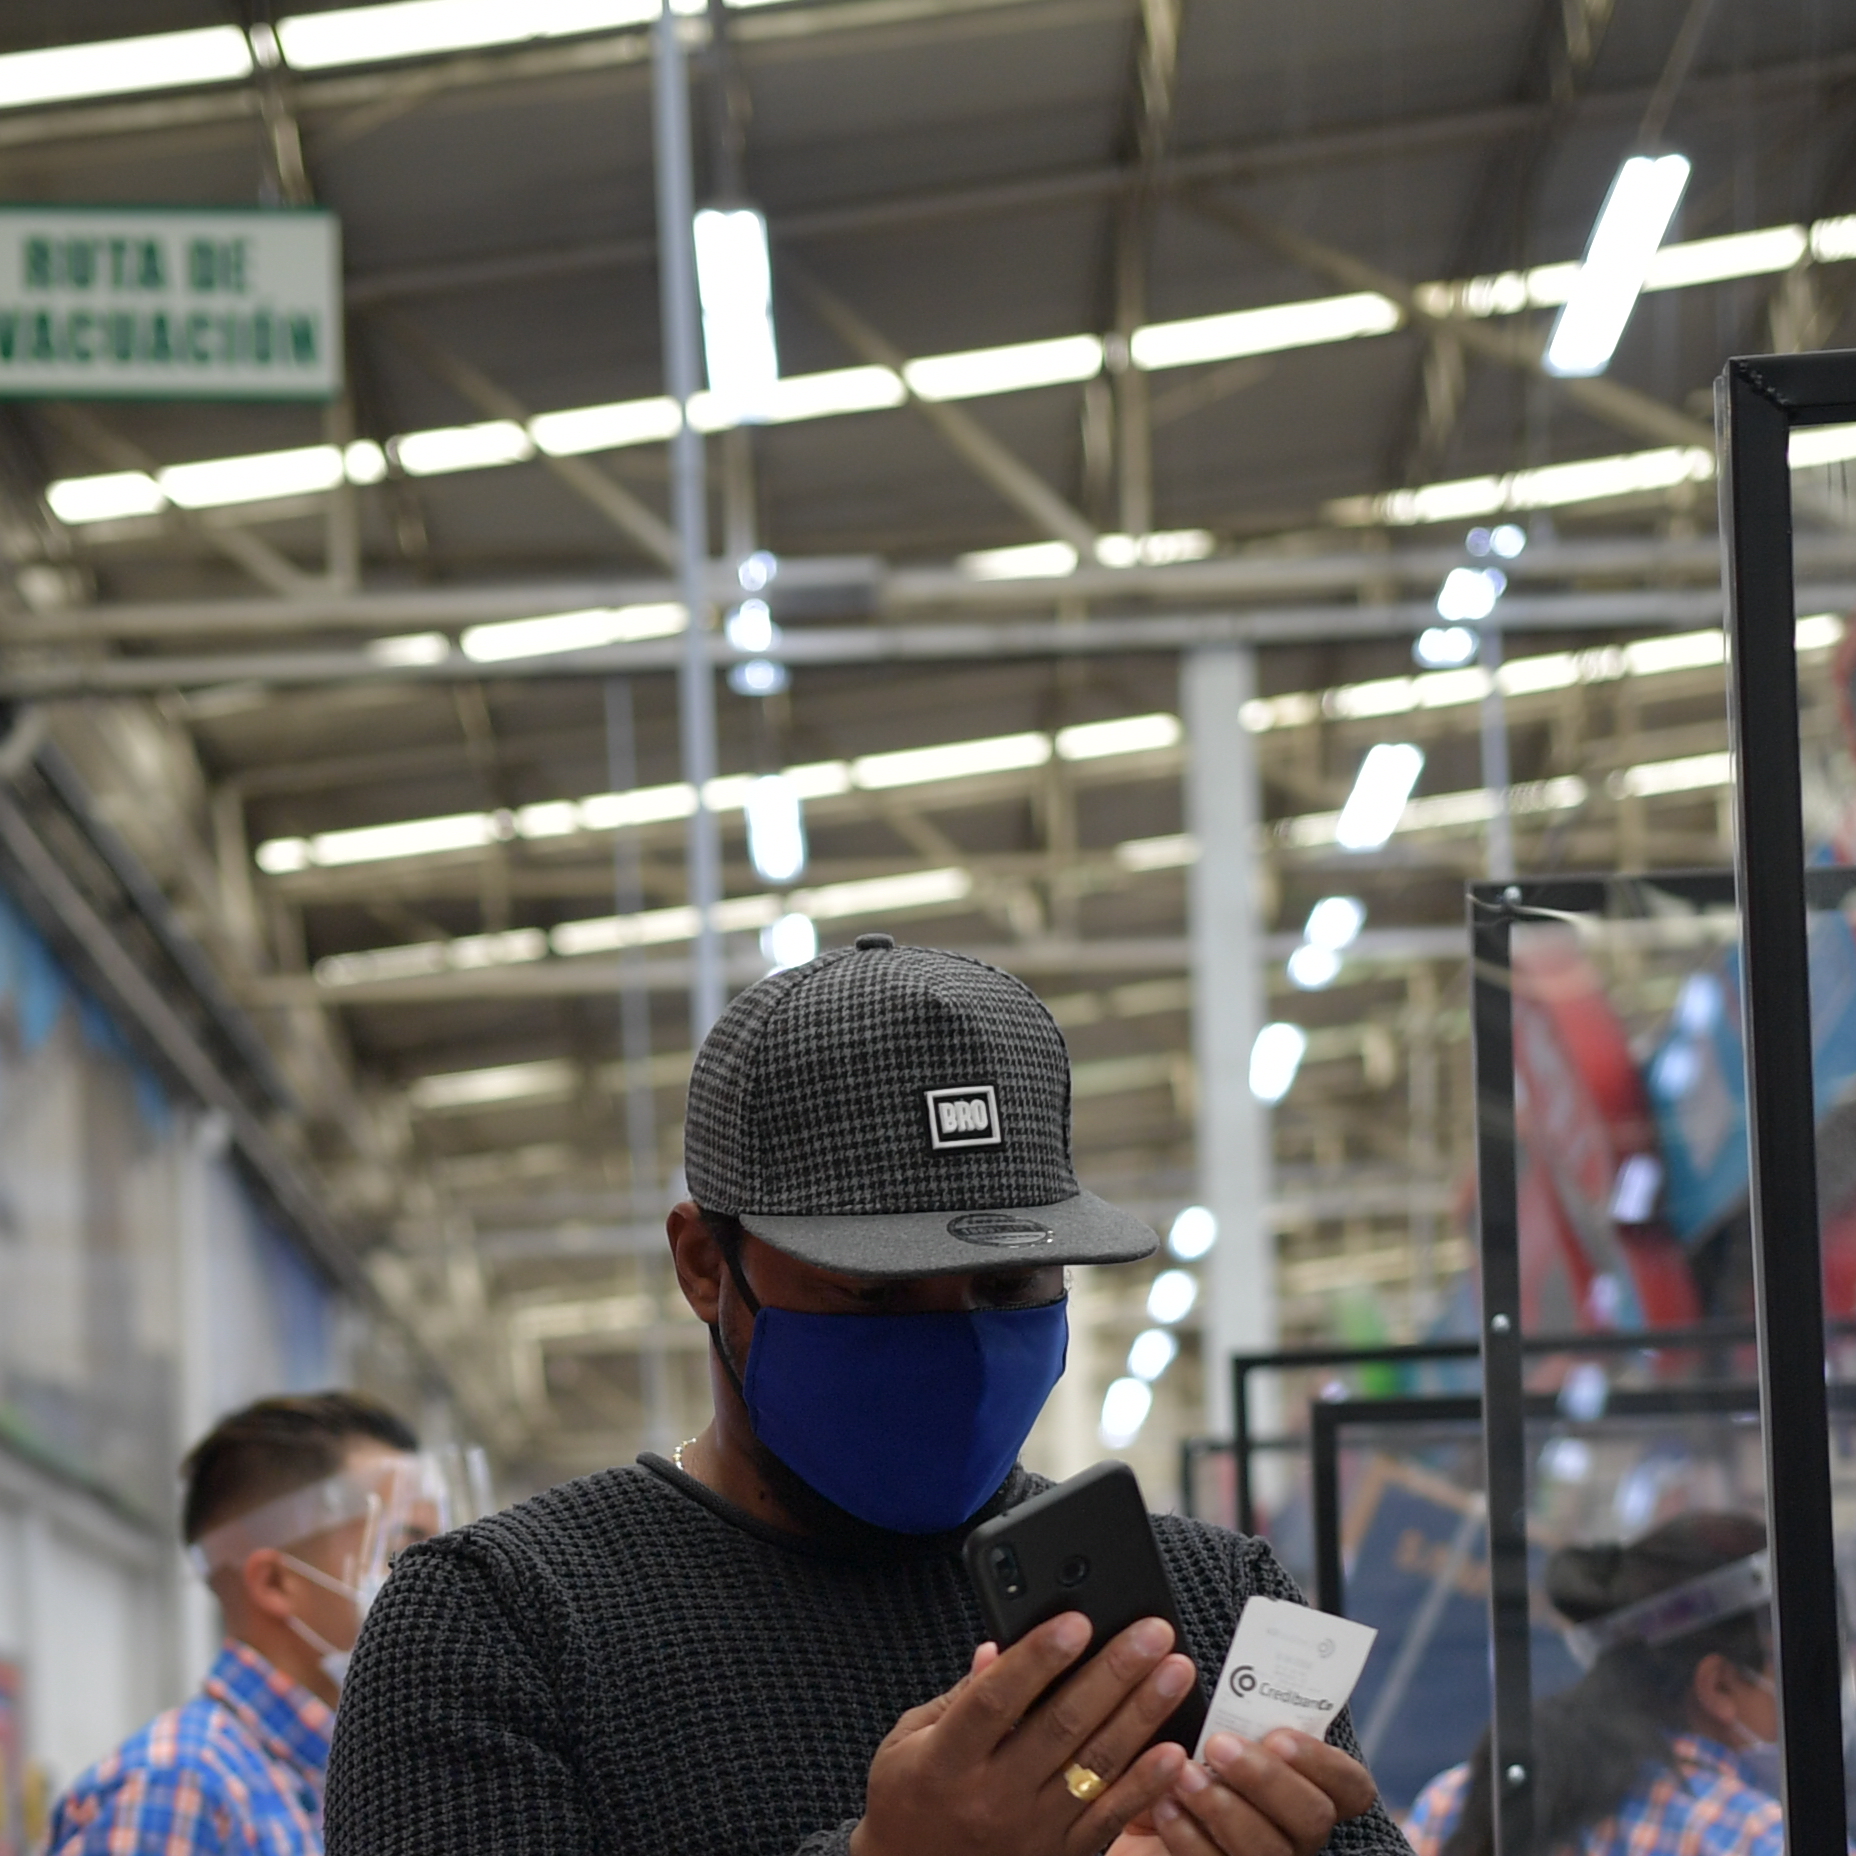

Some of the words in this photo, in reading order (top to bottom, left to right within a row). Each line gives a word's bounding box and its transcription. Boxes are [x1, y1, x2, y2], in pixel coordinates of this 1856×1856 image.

[22, 234, 170, 293] RUTA
[190, 236, 252, 295] DE
[938, 1099, 989, 1133] BRO
